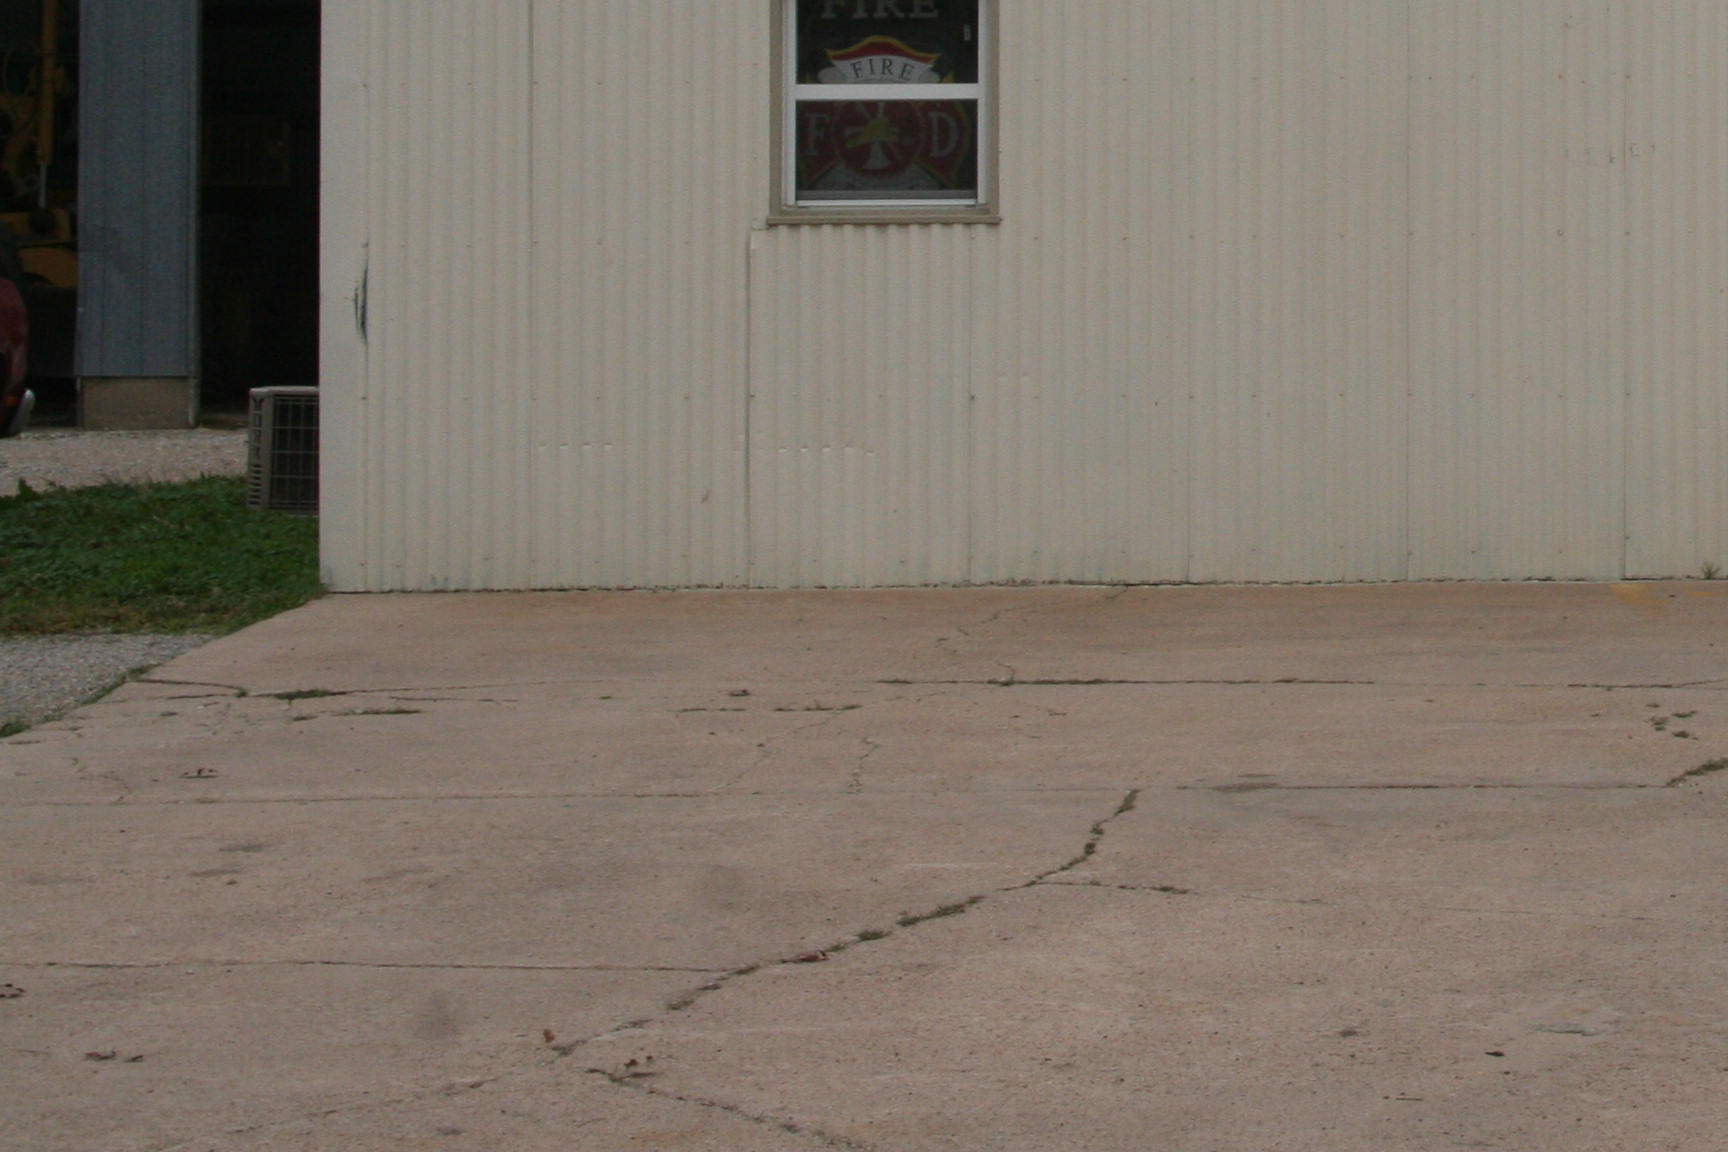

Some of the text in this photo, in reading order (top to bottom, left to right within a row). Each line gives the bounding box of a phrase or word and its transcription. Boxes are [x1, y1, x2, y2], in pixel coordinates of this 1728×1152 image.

[850, 58, 915, 82] FIRE
[802, 111, 959, 158] F D
